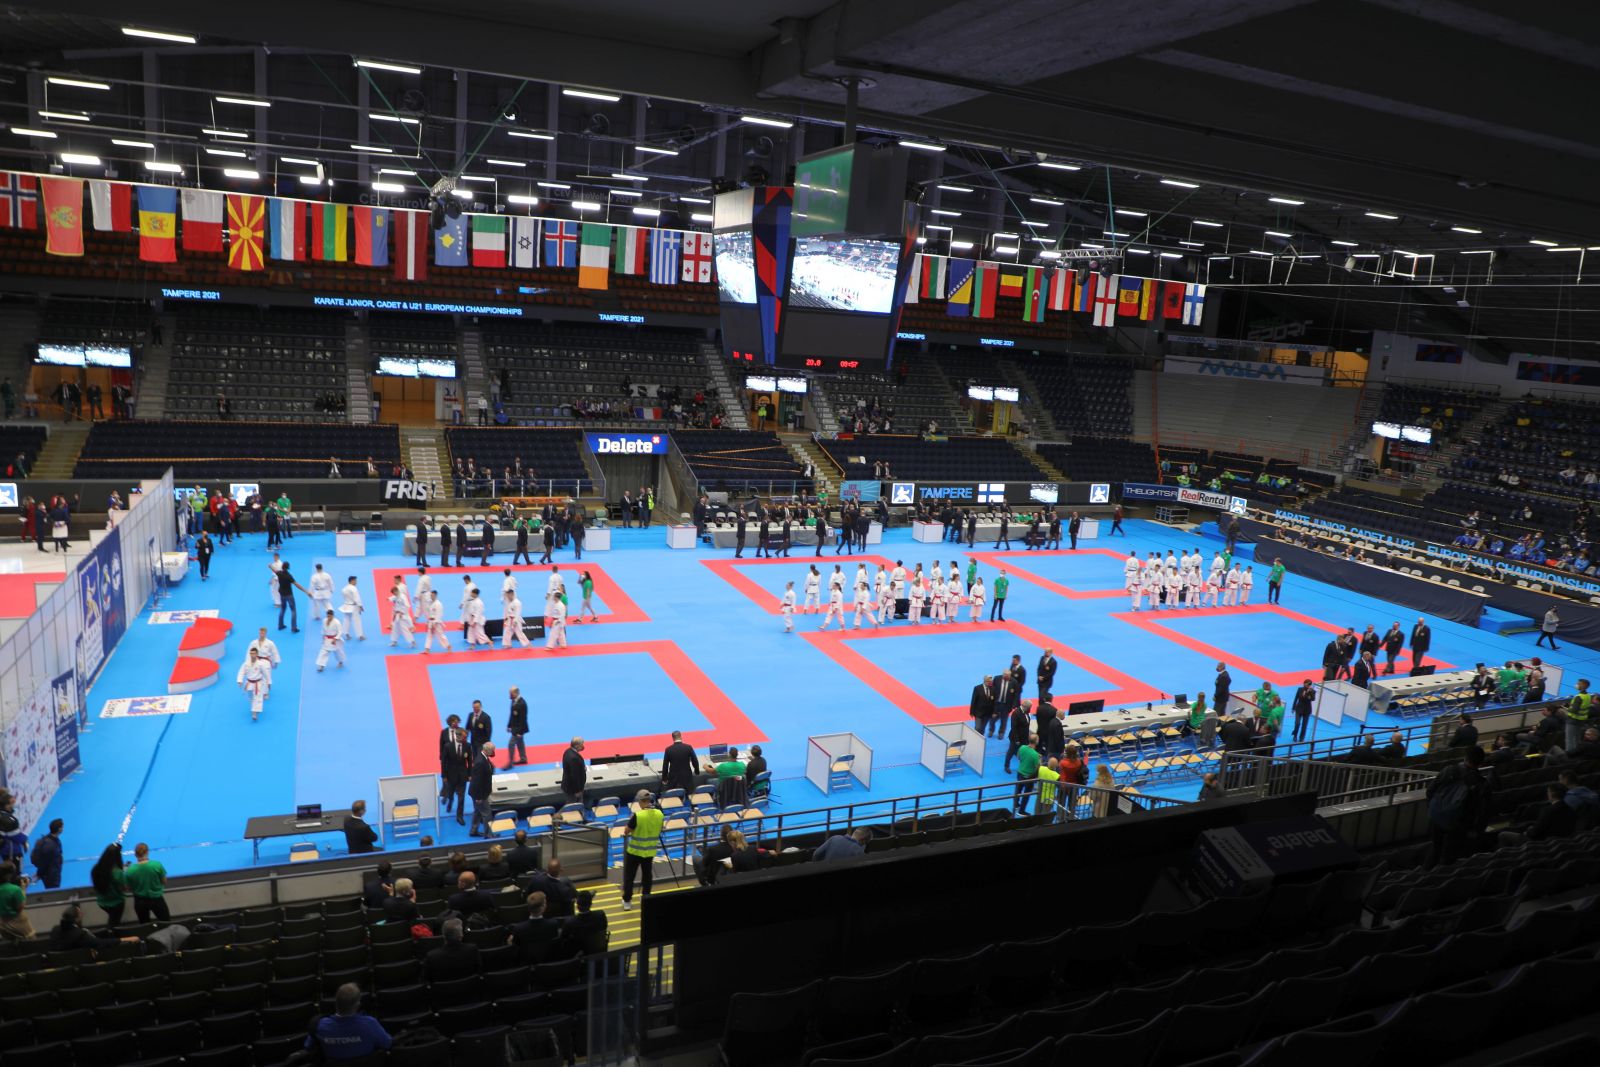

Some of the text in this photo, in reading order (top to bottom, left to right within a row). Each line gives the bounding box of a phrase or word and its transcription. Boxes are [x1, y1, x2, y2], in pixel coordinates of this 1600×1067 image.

[161, 288, 220, 299] TAMPERE 2021
[314, 297, 344, 306] KARATE
[345, 299, 375, 308] JUNIOR,
[376, 301, 402, 309] CADET
[409, 302, 422, 310] U21
[424, 303, 465, 312] EUROPEAN
[465, 305, 523, 315] CHAMPIONSHIPS
[598, 313, 645, 323] TAMPERE 2021
[896, 332, 926, 340] PIONSHIPS
[597, 437, 653, 453] Delete
[919, 487, 973, 499] TAMPERE
[1180, 489, 1227, 506] RealRental
[1275, 509, 1310, 523] KARATE
[1495, 562, 1600, 593] CHAMPIONSHIP
